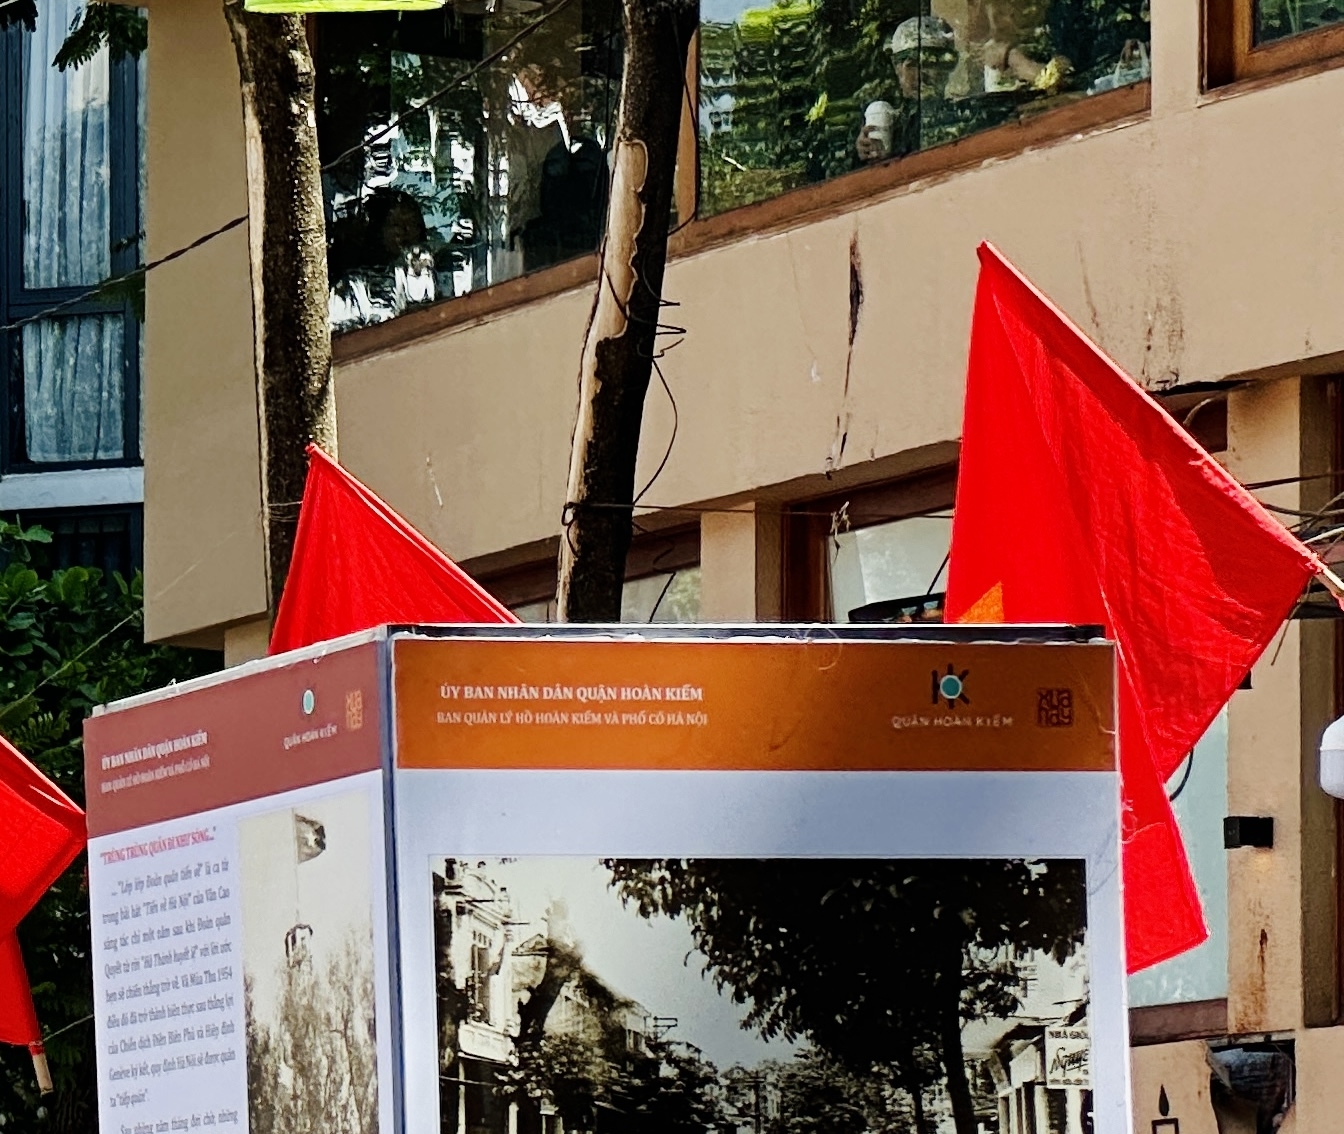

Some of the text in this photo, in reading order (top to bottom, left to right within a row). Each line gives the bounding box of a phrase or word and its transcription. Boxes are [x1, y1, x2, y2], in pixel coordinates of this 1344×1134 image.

[464, 686, 494, 699] BAN
[497, 684, 539, 700] NHÂN
[542, 683, 573, 700] DÂN
[576, 684, 616, 703] QUẬN
[620, 684, 662, 701] HOÀN
[665, 683, 703, 702] KIẾM
[604, 710, 619, 725] VÀ
[666, 711, 684, 726] HÀ
[685, 711, 708, 728] NỘI
